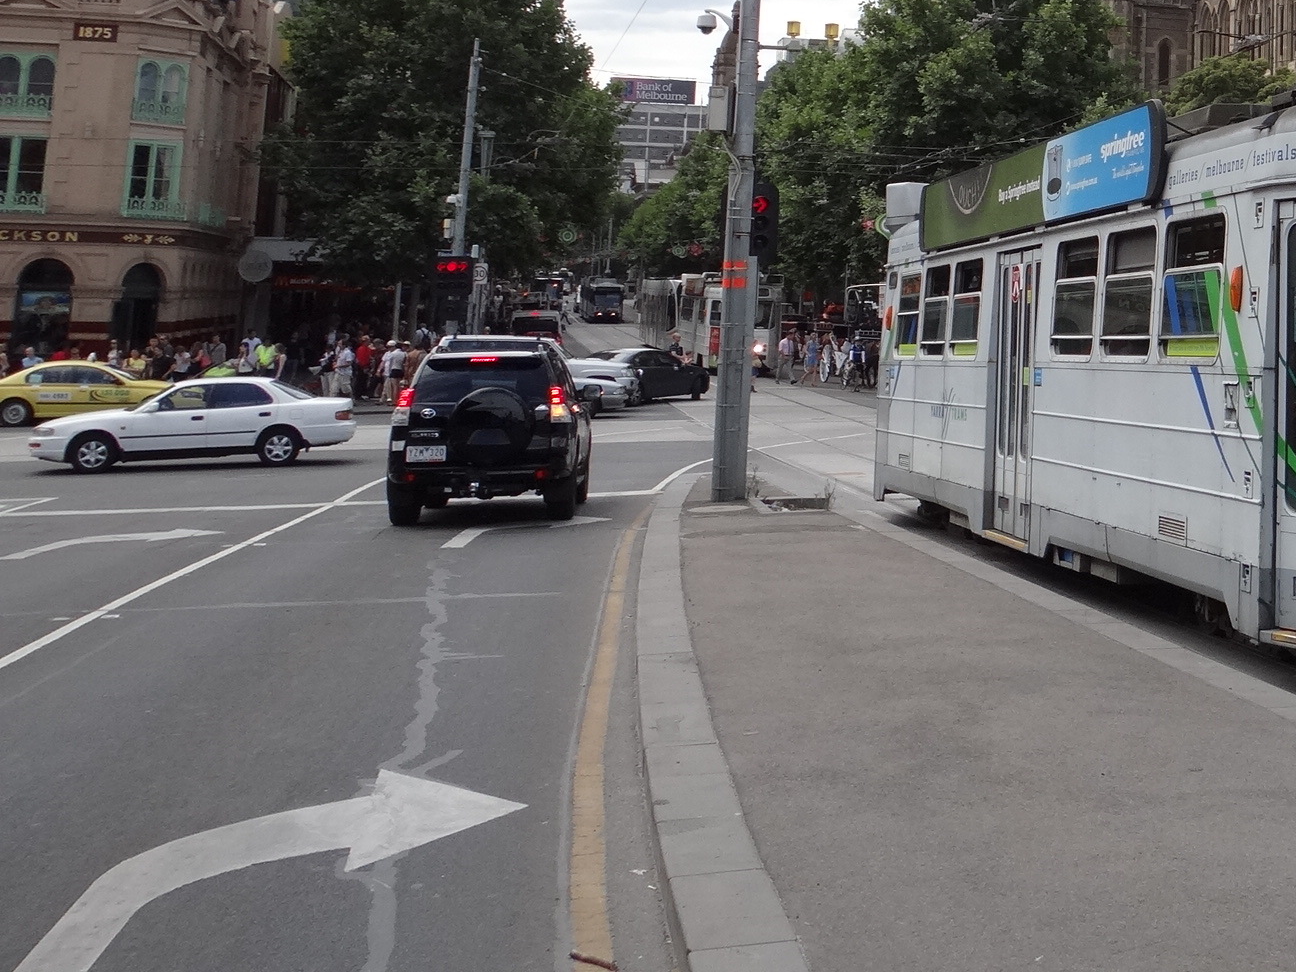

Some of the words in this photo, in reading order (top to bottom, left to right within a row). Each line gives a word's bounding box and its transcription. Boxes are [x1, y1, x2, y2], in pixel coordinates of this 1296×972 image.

[78, 26, 112, 39] 1875
[636, 81, 660, 92] Bank
[662, 81, 672, 91] of
[636, 90, 687, 102] Melbourne
[1101, 130, 1145, 163] springfree
[1168, 168, 1199, 189] galleries
[1206, 153, 1245, 178] melbourne
[1252, 143, 1296, 167] festivals
[0, 230, 79, 242] CKSON
[474, 269, 485, 278] 30
